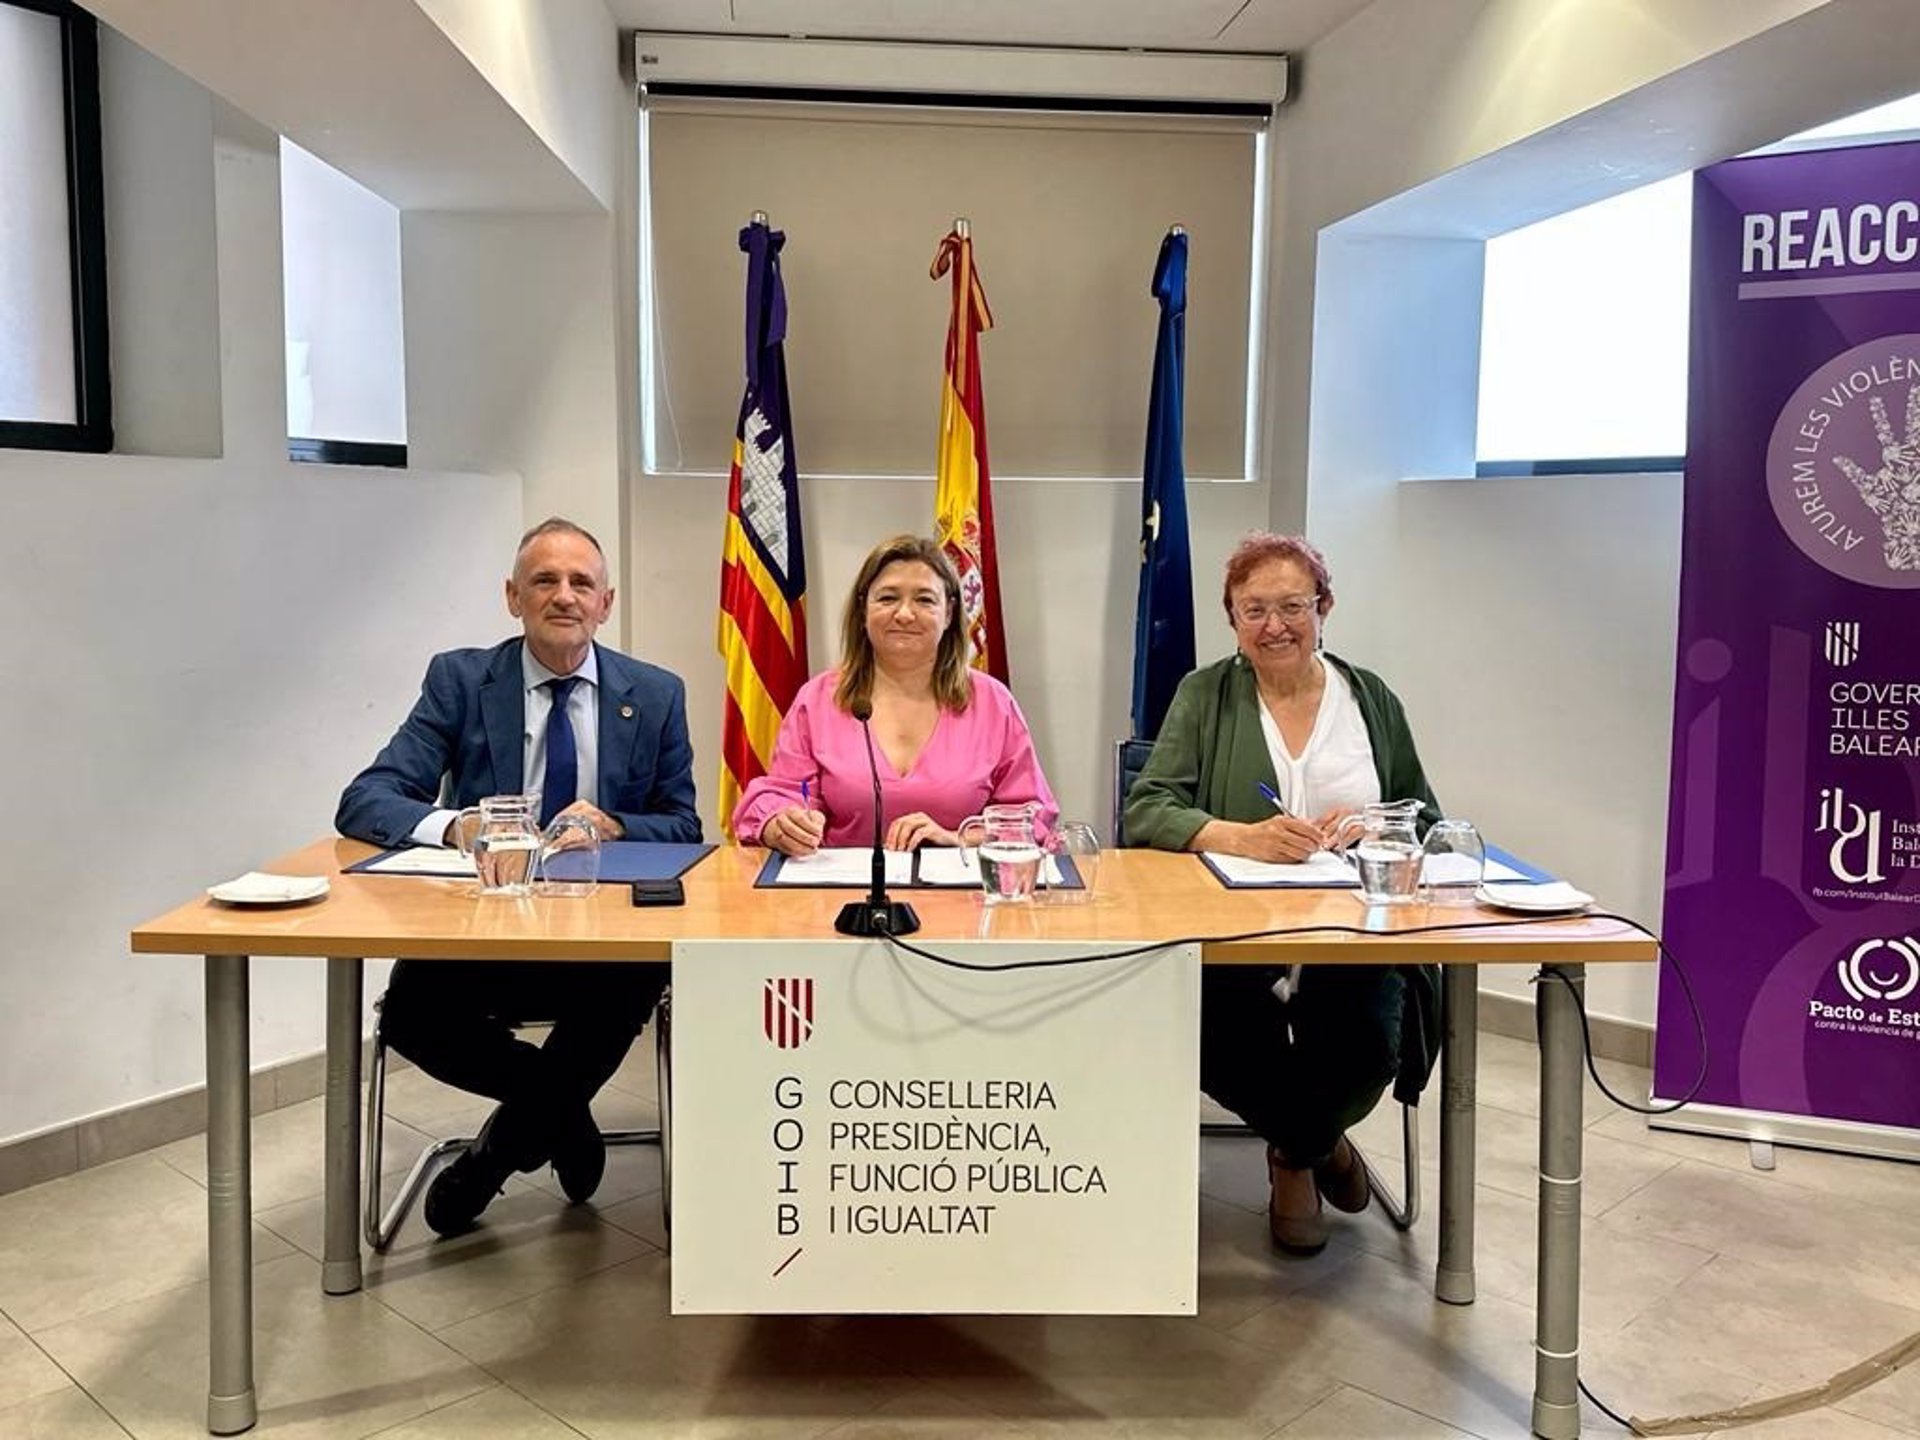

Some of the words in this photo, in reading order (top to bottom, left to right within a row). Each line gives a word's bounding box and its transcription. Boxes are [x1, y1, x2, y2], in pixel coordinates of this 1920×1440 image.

[1742, 201, 1918, 272] REACC
[1795, 408, 1831, 454] LES
[1792, 460, 1864, 551] ATUREM
[1831, 708, 1910, 731] ILLES
[1891, 852, 1905, 867] la
[1809, 1000, 1865, 1021] Pacto
[1868, 1012, 1884, 1023] de
[1814, 1020, 1846, 1031] contra
[1846, 1022, 1857, 1032] la
[1858, 1024, 1900, 1036] violencia
[1901, 1028, 1914, 1038] de
[829, 1079, 1057, 1110] CONSELLERIA
[829, 1115, 1051, 1157] PRESIDÈNCIA,
[829, 1156, 957, 1193] FUNCIÓ
[967, 1157, 1108, 1194] PÚBLICA
[829, 1205, 836, 1234] I
[847, 1204, 996, 1234] IGUALTAT
